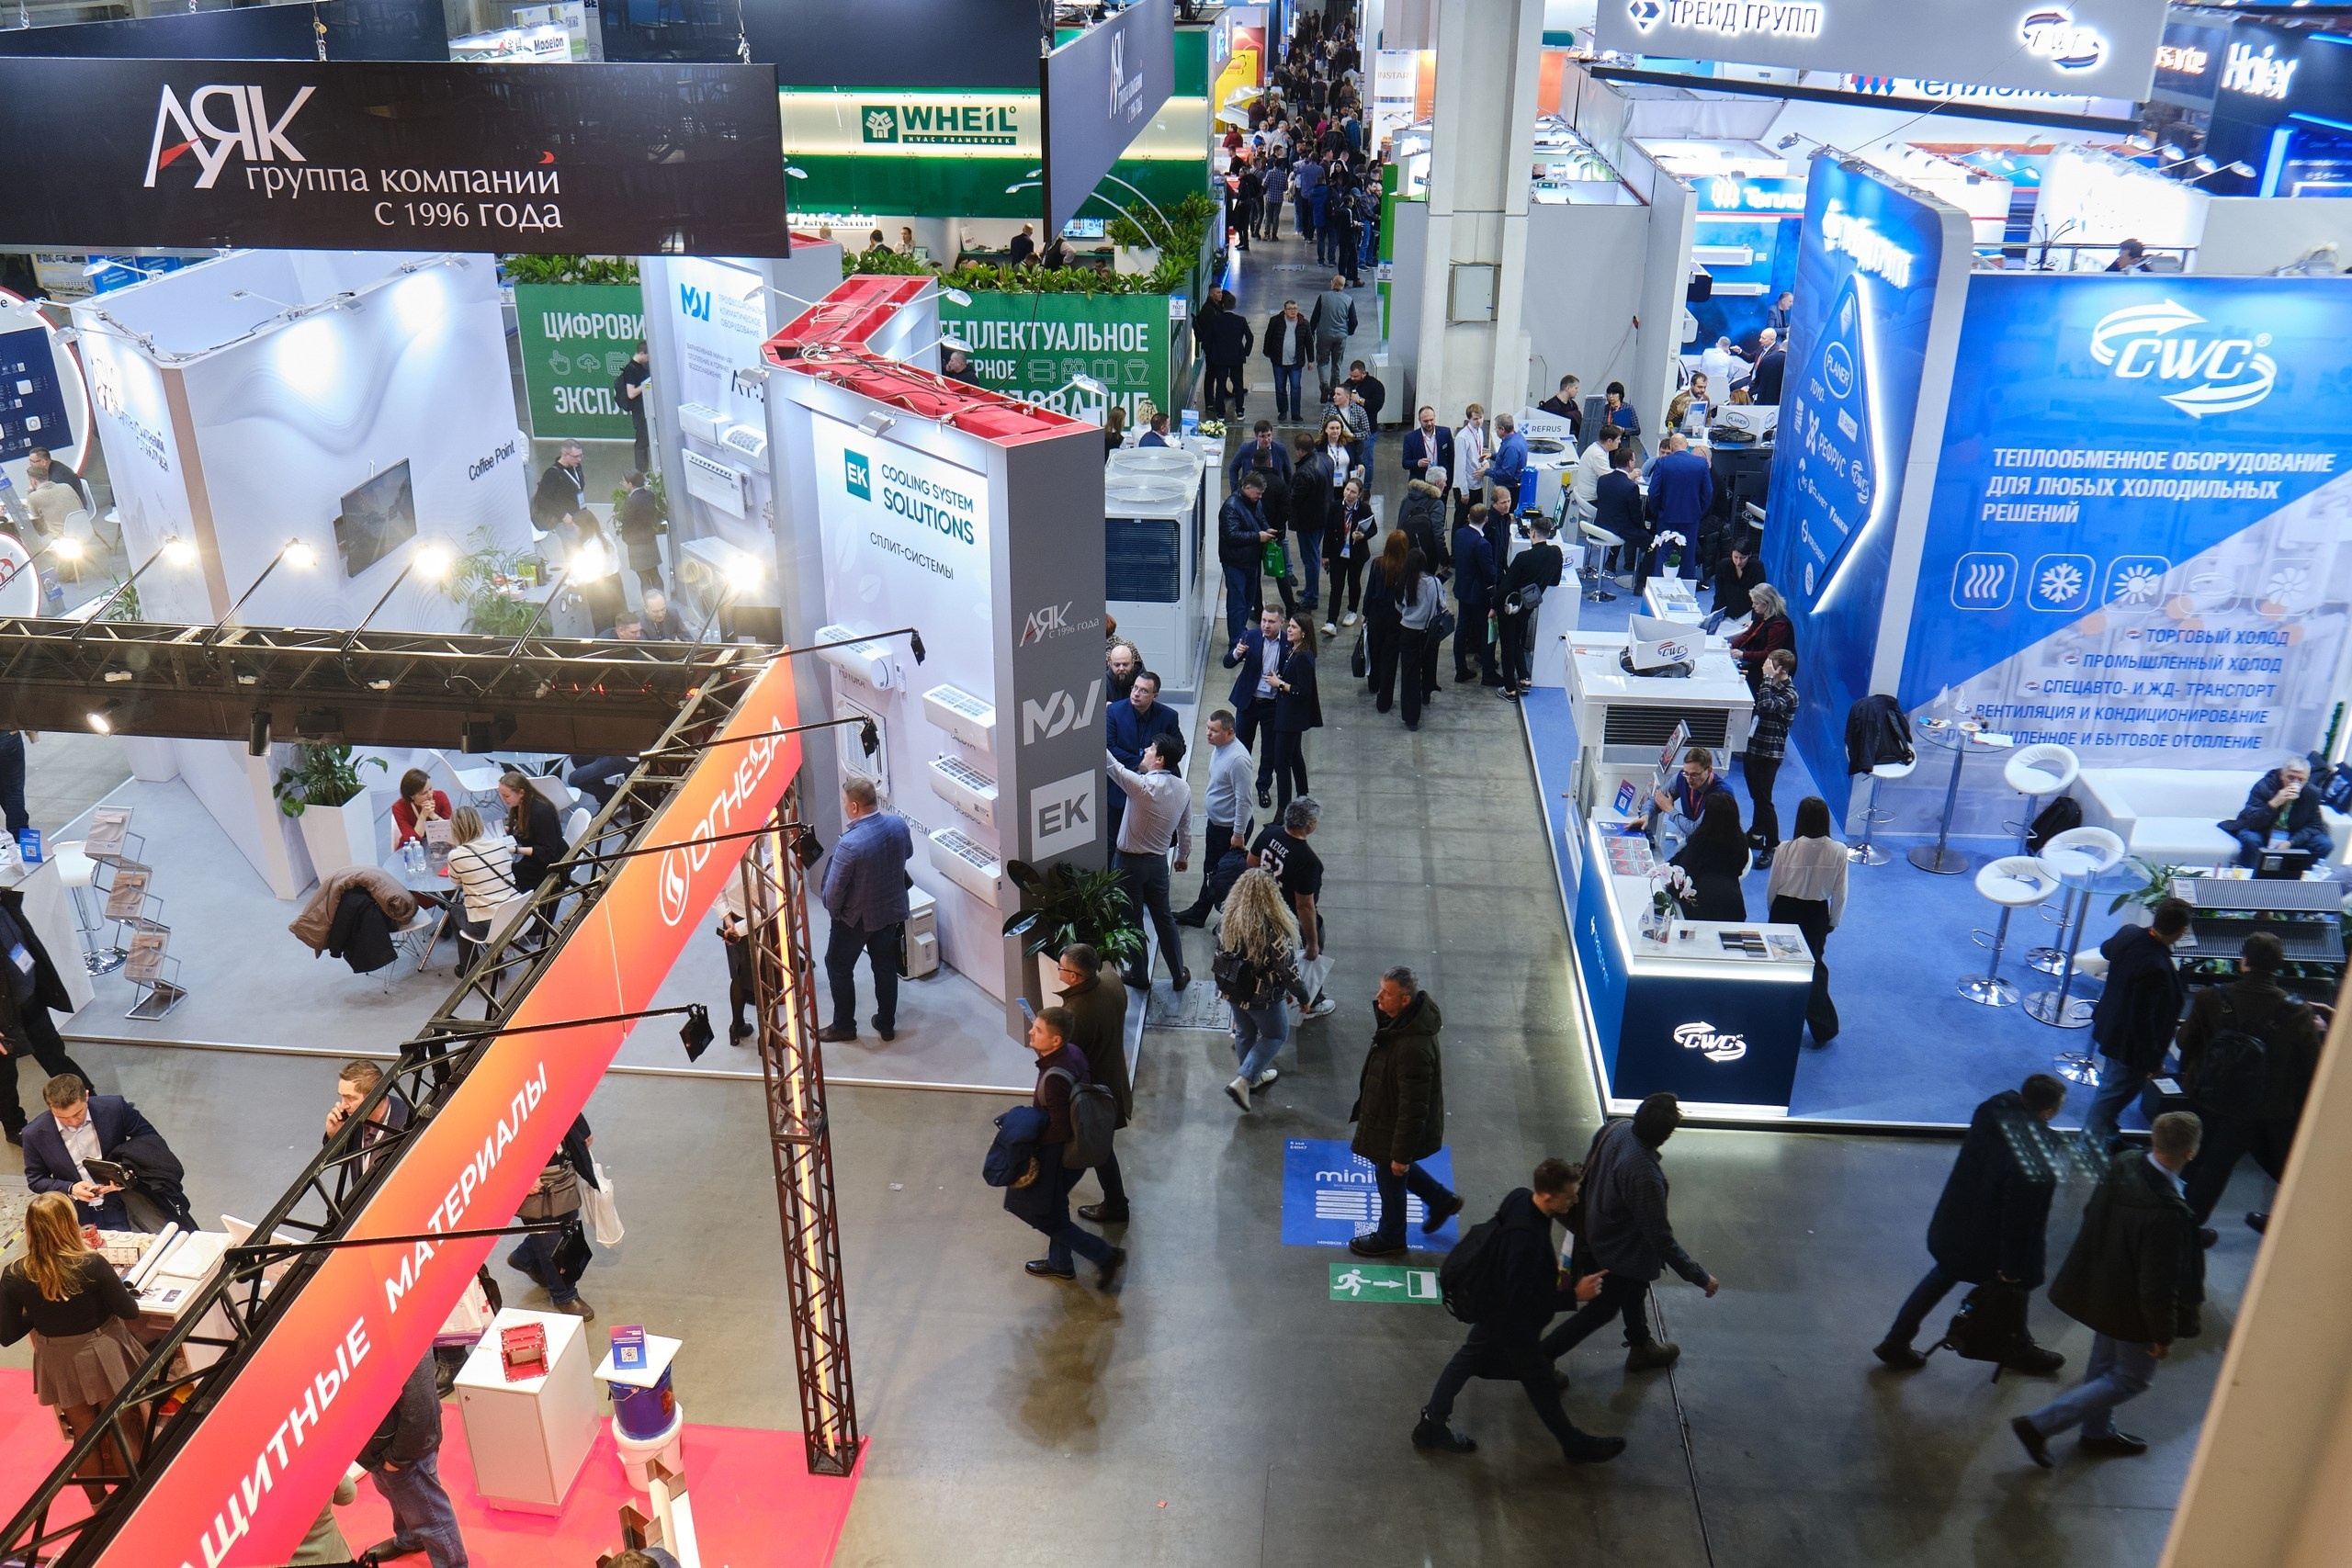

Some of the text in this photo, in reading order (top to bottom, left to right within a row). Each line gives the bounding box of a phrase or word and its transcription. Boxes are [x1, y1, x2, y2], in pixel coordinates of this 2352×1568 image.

[1744, 4, 1817, 34] ГРУПП
[246, 166, 560, 198] группа компании
[404, 202, 470, 227] 1996
[478, 202, 563, 232] года
[1826, 354, 1851, 387] PLANER
[469, 440, 515, 480] Coffee Point
[1818, 433, 1847, 479] РЕФРУС
[1993, 448, 2337, 475] ТЕПЛООБМЕННОЕ ОБОРУДОВАНИЕ
[847, 462, 868, 488] EK
[881, 463, 974, 513] COOLING SYSTEM
[1985, 476, 2282, 502] ДЛЯ ЛЮБЫХ ХОЛОДИЛЬНЫХ
[883, 487, 975, 545] SOLUTIONS
[1981, 500, 2080, 524] РЕШЕНИЙ
[869, 532, 954, 581] СПЛИТ-СИСТЕМЫ
[1057, 625, 1075, 637] 1996
[1077, 617, 1100, 632] года
[2147, 628, 2290, 648] ТОРГОВЫЙ ХОЛОД
[2082, 653, 2283, 674] ПРОМЫШЛЕННЫЙ ХОЛОД
[2132, 682, 2144, 696] И
[2186, 683, 2278, 699] ТРАНСПОРТ
[1976, 704, 2269, 725] ВЕНТИЛЯЦИЯ И КОНДИЦИОНИРОВАНИЕ
[2080, 731, 2092, 745] И
[2095, 732, 2168, 748] БЫТОВОЕ
[2172, 733, 2263, 750] ОТОПЛЕНИЕ
[1039, 792, 1090, 839] EK
[384, 1062, 548, 1314] МАТЕРИАЛЫ
[1316, 1169, 1377, 1184] mini
[181, 1316, 370, 1568] ЩИТНЫЕ
